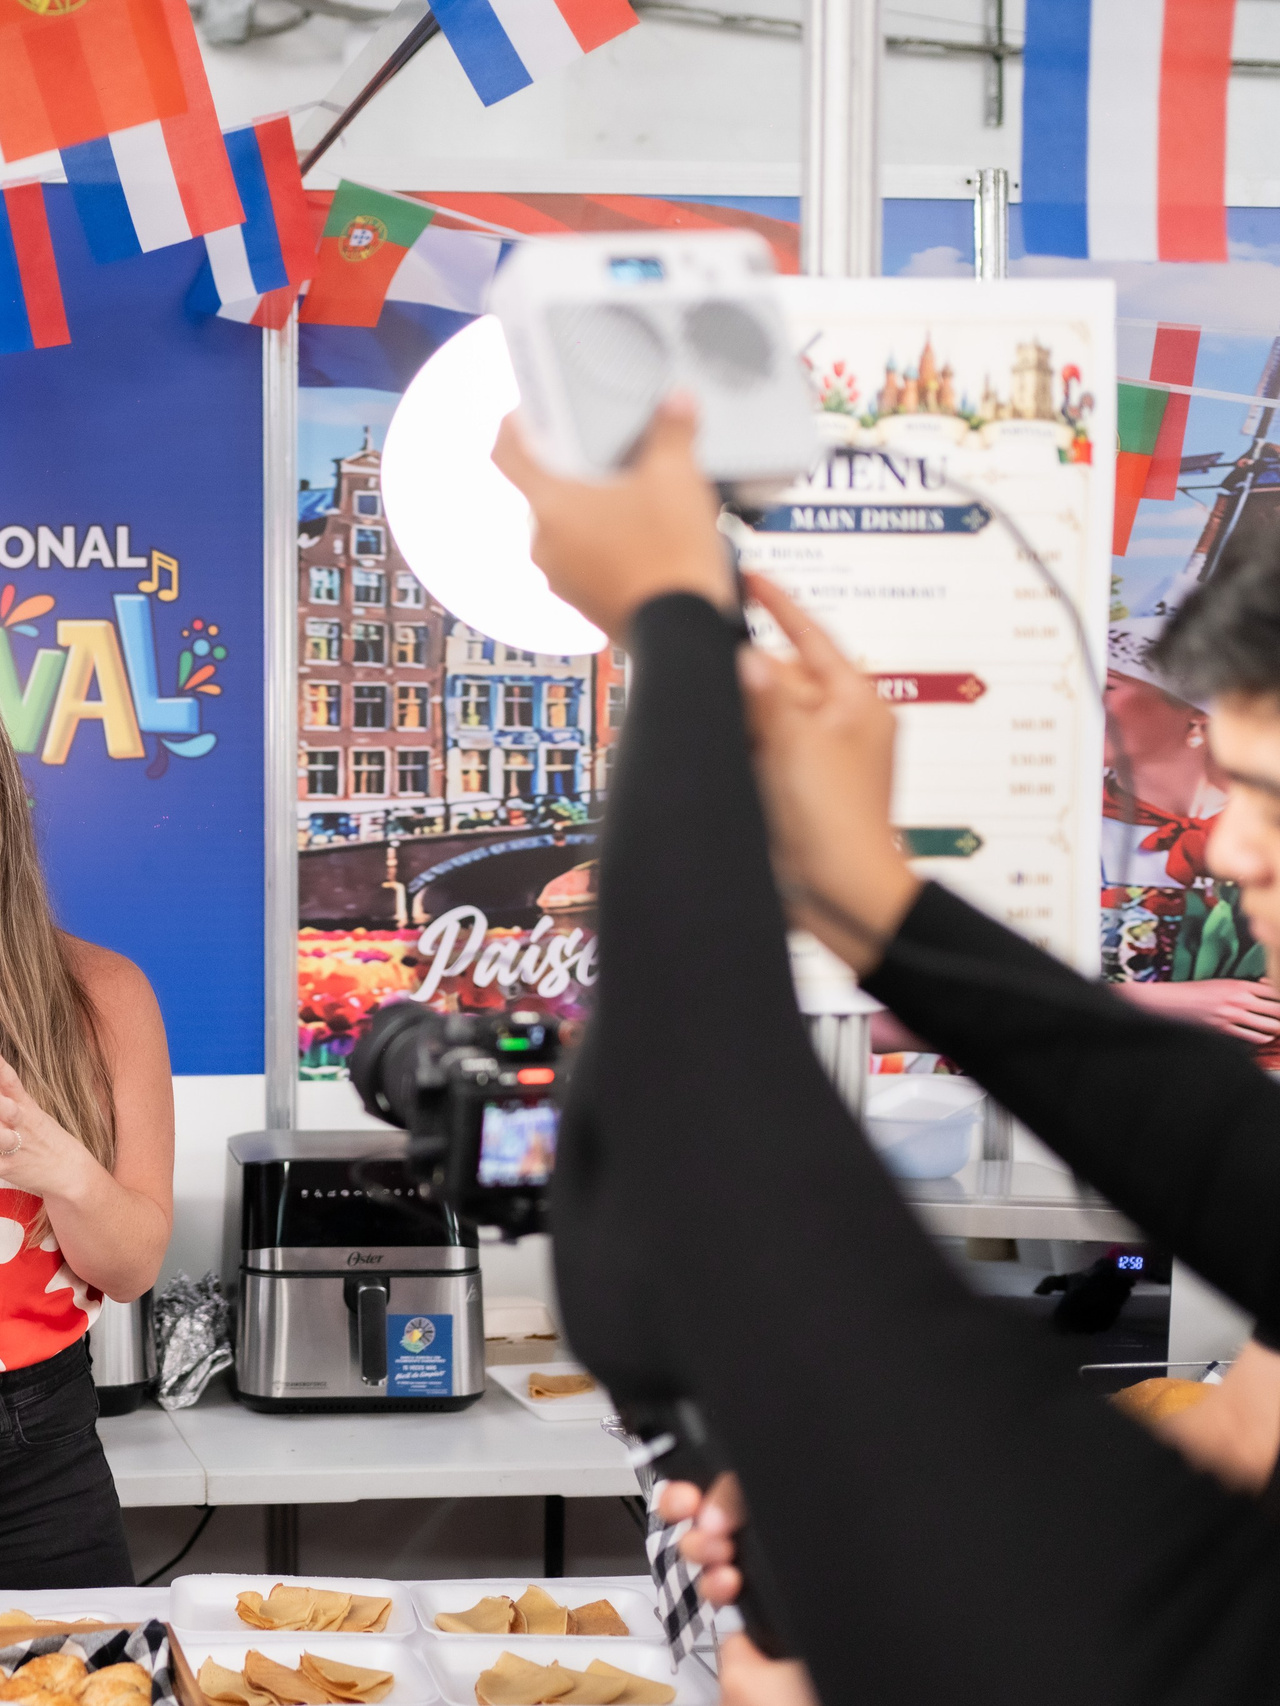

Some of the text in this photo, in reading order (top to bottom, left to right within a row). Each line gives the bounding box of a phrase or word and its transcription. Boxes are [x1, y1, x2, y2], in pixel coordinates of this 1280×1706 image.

[790, 506, 945, 532] MAIN DISHES
[347, 1251, 384, 1267] Oster
[1118, 1255, 1144, 1269] 12:58
